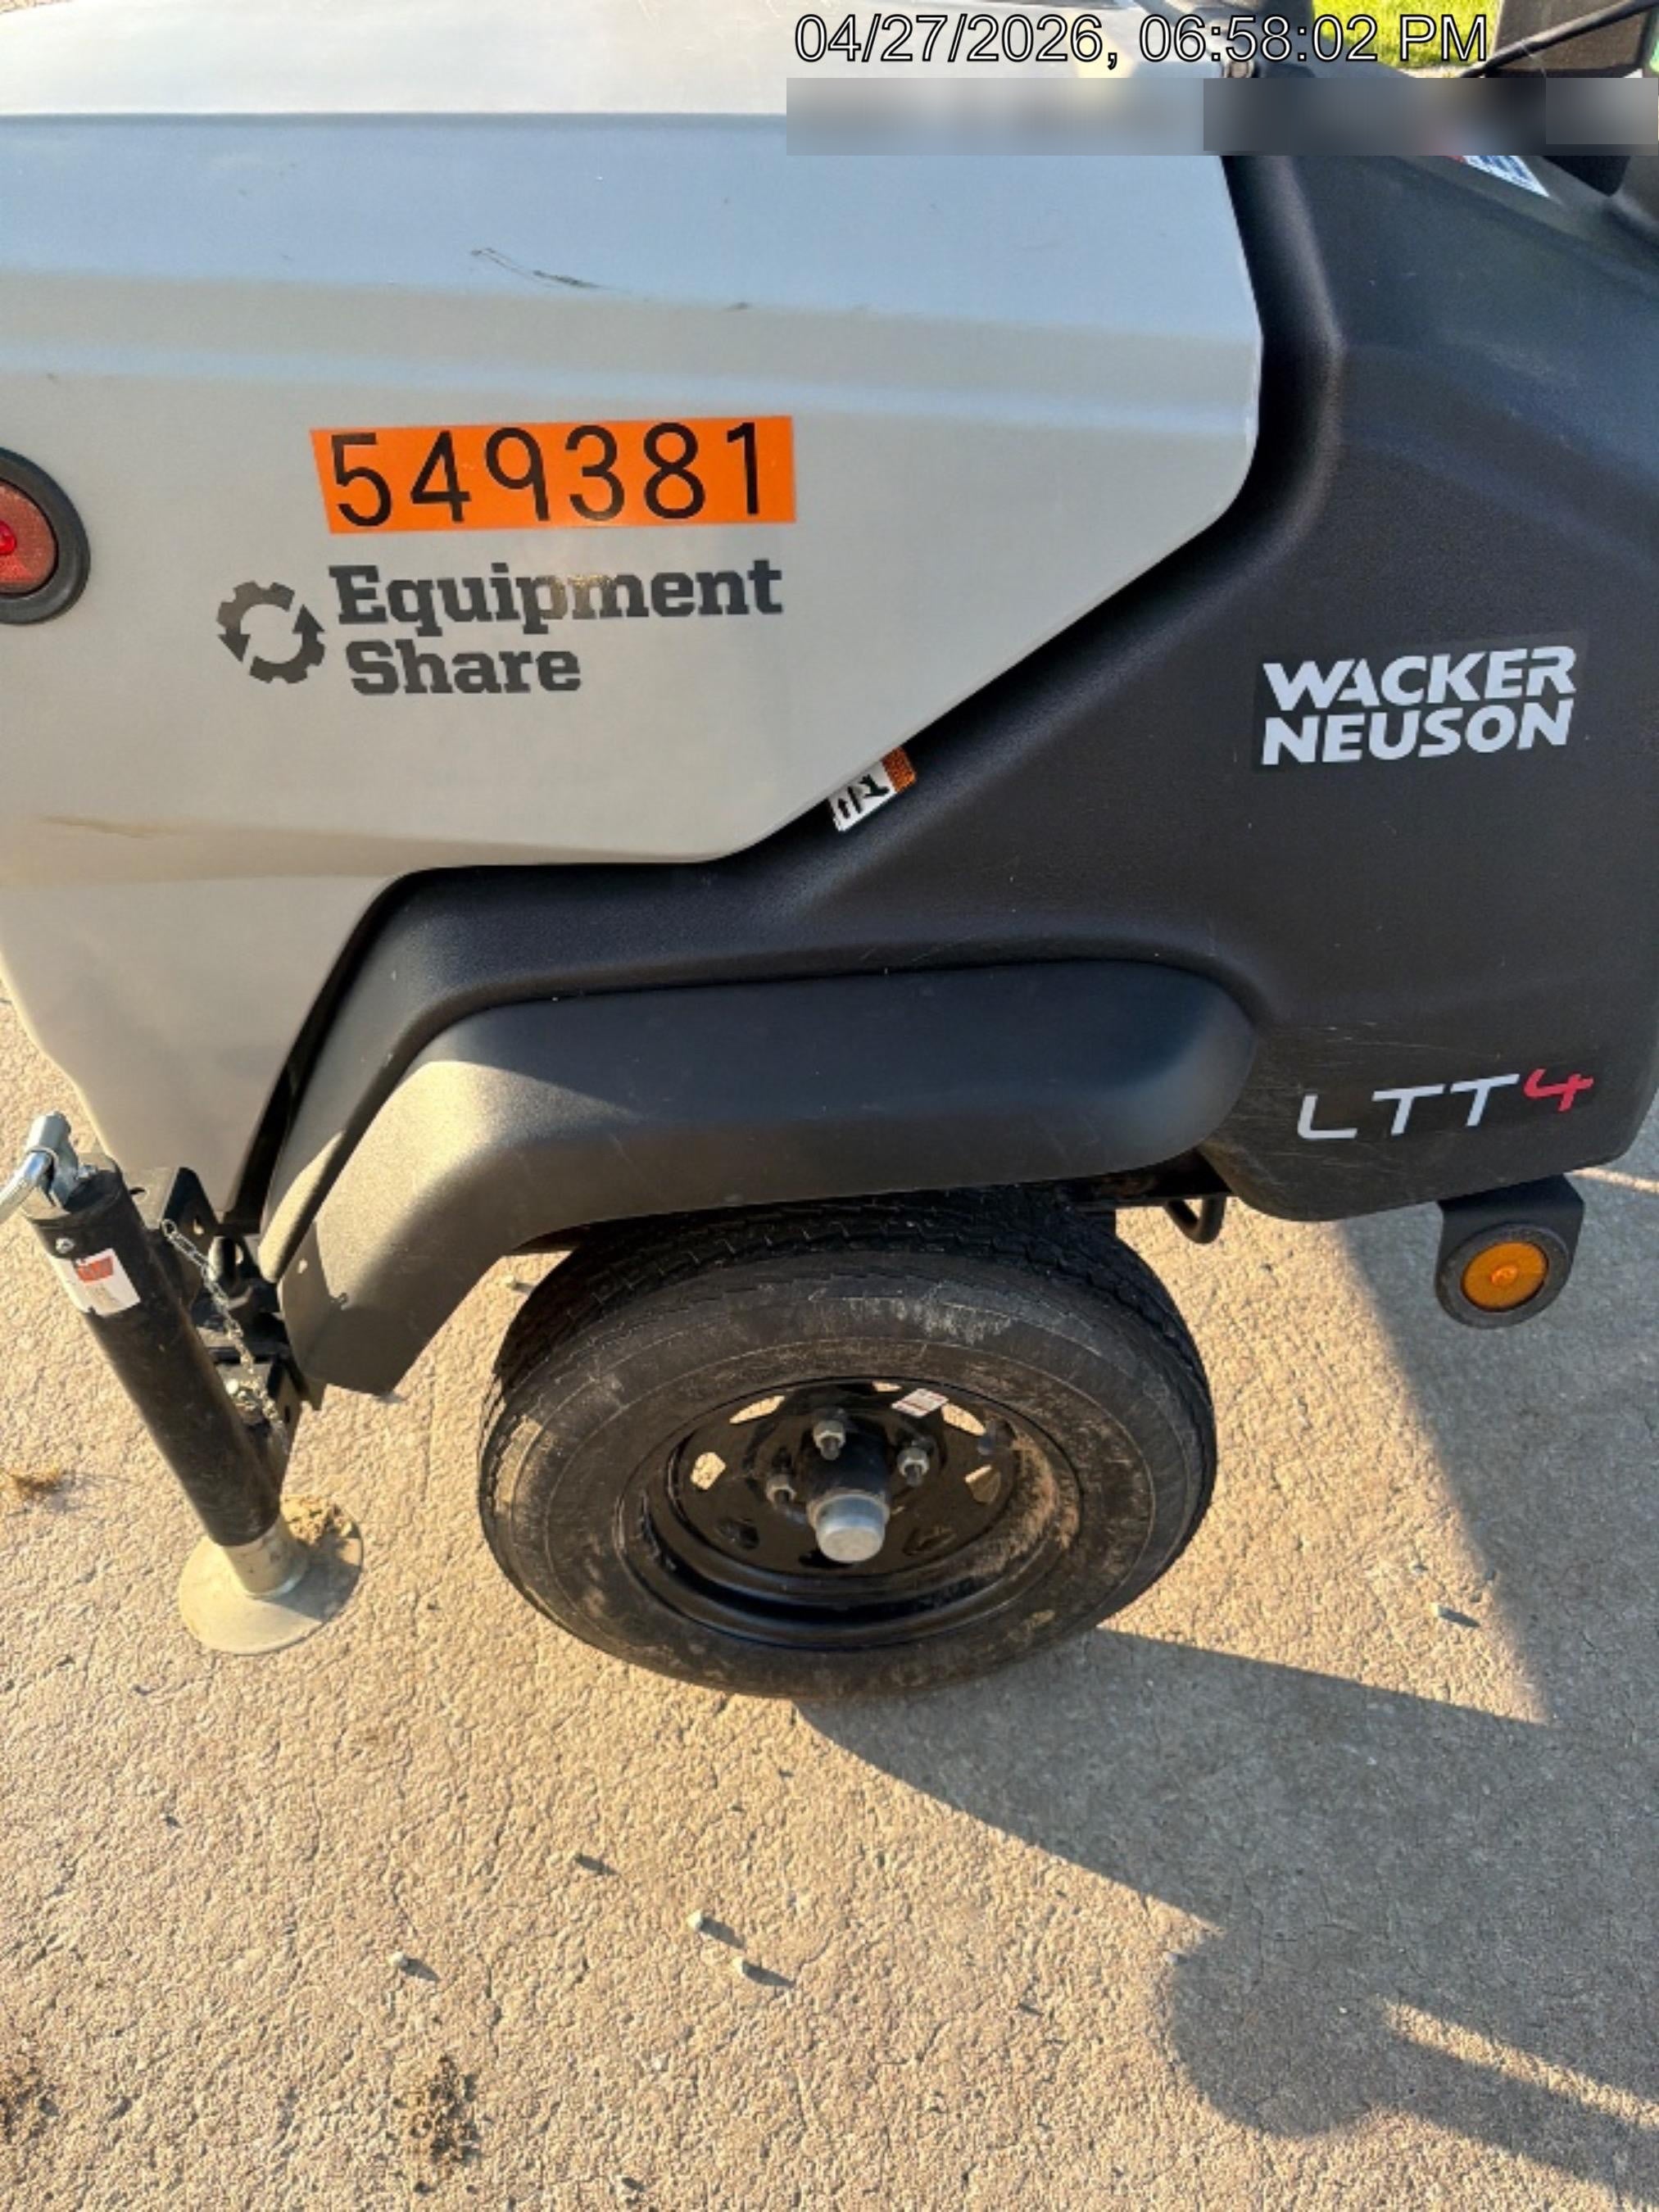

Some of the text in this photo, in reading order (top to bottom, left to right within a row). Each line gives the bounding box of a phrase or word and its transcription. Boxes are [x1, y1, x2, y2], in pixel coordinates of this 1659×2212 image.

[330, 422, 759, 527] 549381
[329, 560, 783, 637] Equipment
[345, 638, 582, 695] Share
[1262, 646, 1577, 711] WACKER
[1261, 697, 1575, 765] NEUSON
[1297, 1068, 1594, 1140] LTT4
